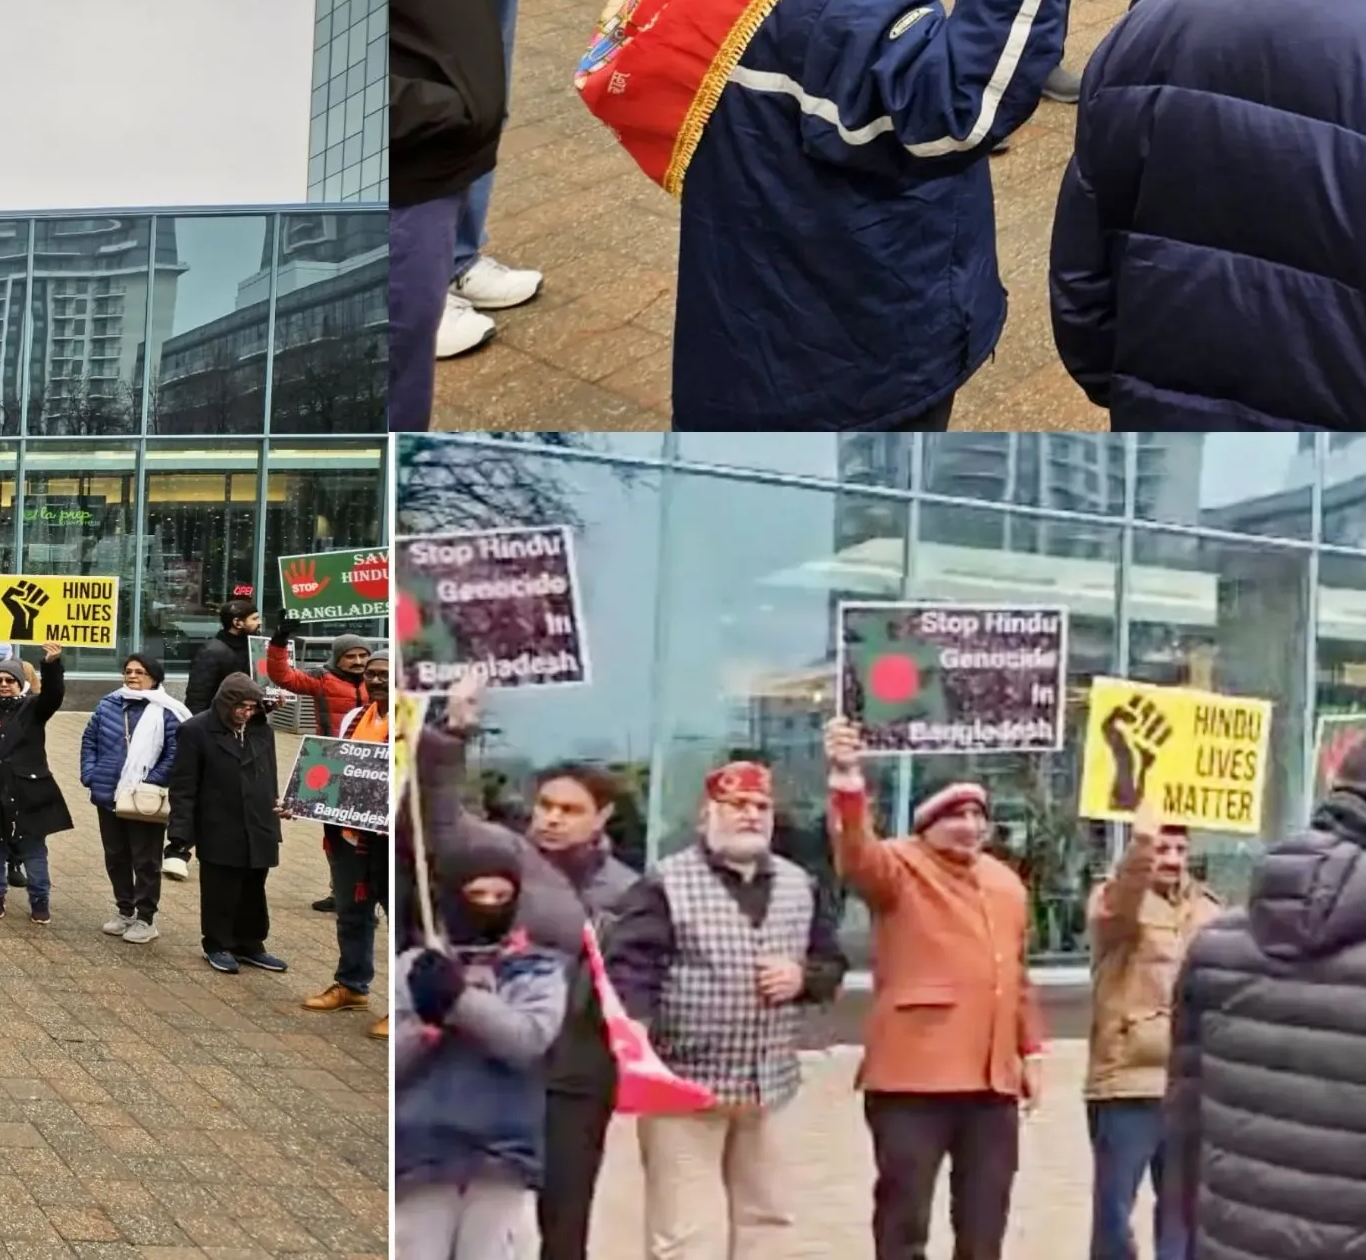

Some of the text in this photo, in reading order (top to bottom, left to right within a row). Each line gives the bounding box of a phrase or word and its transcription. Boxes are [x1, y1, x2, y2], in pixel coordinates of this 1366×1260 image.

[58, 510, 92, 524] prep
[354, 552, 389, 566] SAV
[409, 535, 560, 565] Stop Hindu
[63, 582, 112, 600] HINDU
[292, 583, 318, 593] STOP
[437, 572, 567, 602] Genocide
[67, 603, 111, 621] LIVES
[543, 612, 572, 634] In
[46, 624, 110, 643] MATTER
[920, 612, 1059, 636] Stop Hindu
[417, 651, 578, 683] Bangladesh
[939, 648, 1057, 670] Genocide
[1032, 684, 1054, 703] In
[909, 718, 1054, 744] Bangladesh
[1196, 705, 1262, 740] HINDU
[339, 743, 371, 759] Stop
[343, 764, 389, 780] Genoc
[1197, 744, 1257, 783] LIVES
[1163, 783, 1253, 822] MATTER
